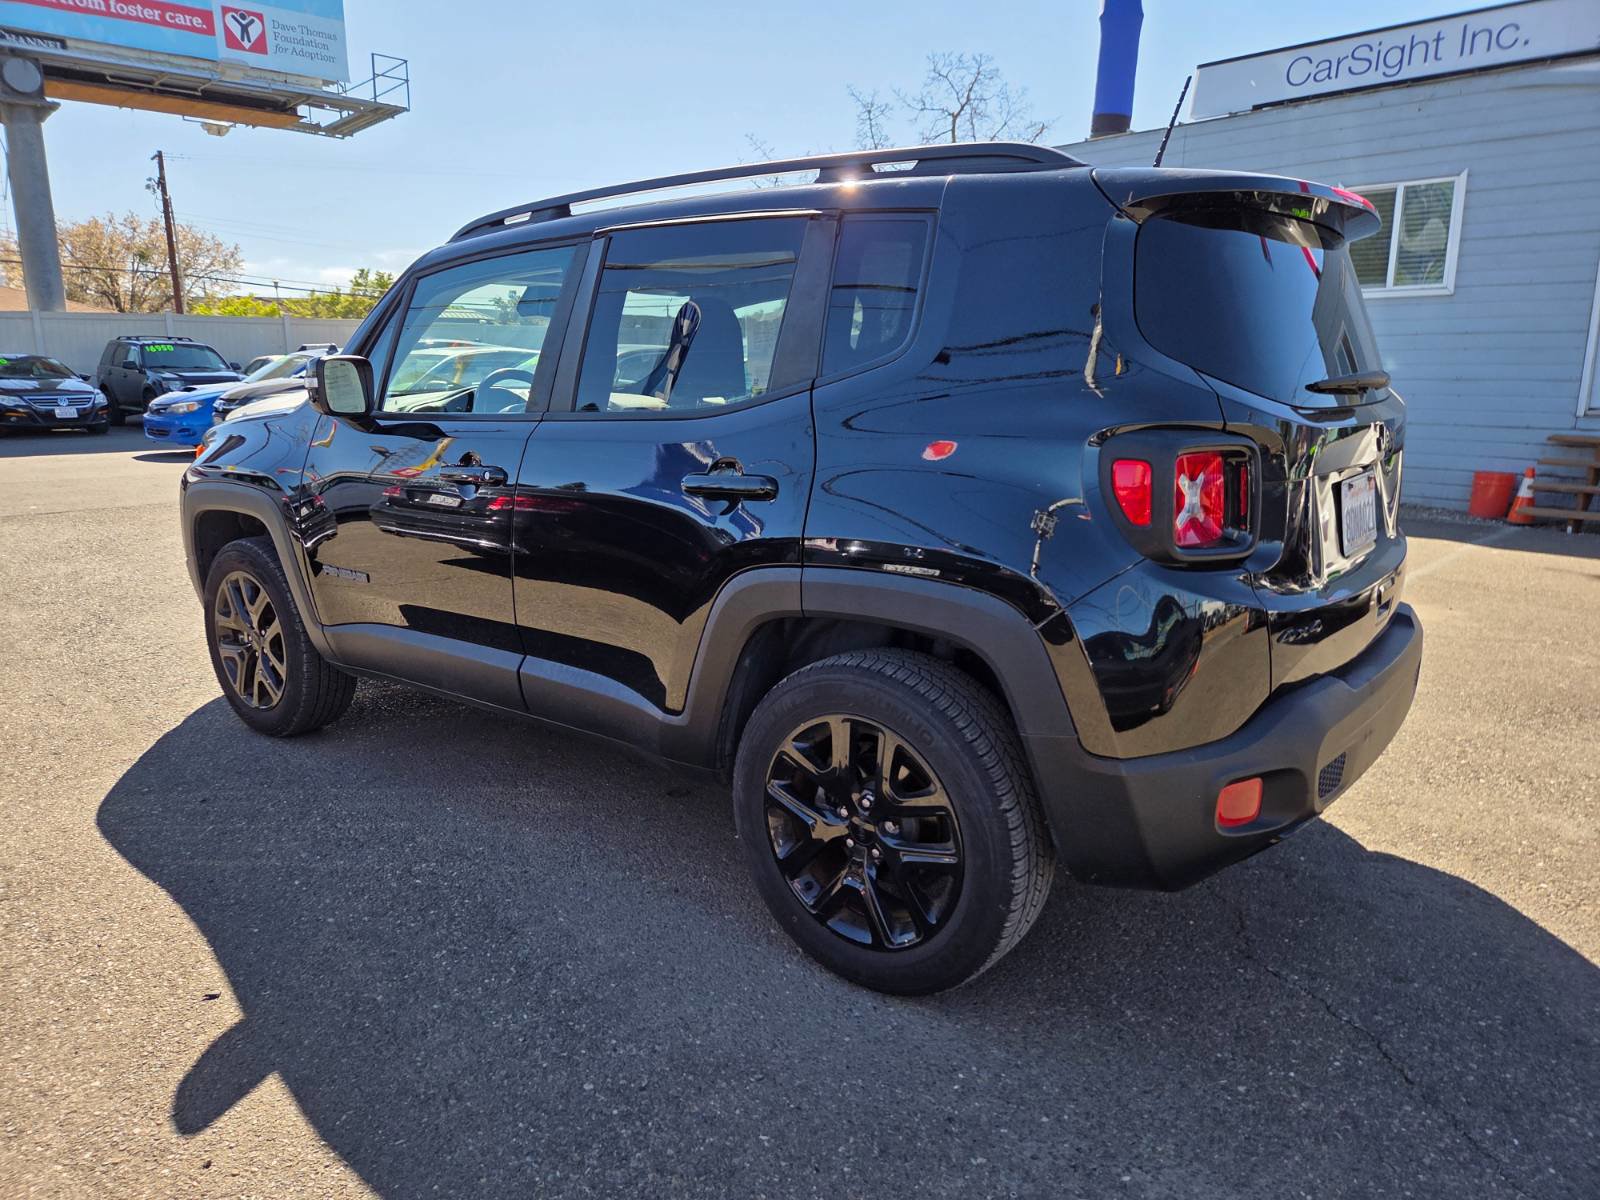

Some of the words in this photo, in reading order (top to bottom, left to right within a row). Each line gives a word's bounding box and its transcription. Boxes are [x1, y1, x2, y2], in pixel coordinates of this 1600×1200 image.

[109, 0, 161, 21] foster
[165, 11, 208, 29] care.
[271, 19, 297, 33] Dave
[298, 24, 338, 41] Thomas
[273, 31, 329, 51] Foundation
[273, 43, 289, 55] for
[291, 46, 337, 63] Adoption
[1285, 31, 1445, 87] CarSight
[1459, 22, 1531, 57] Inc.
